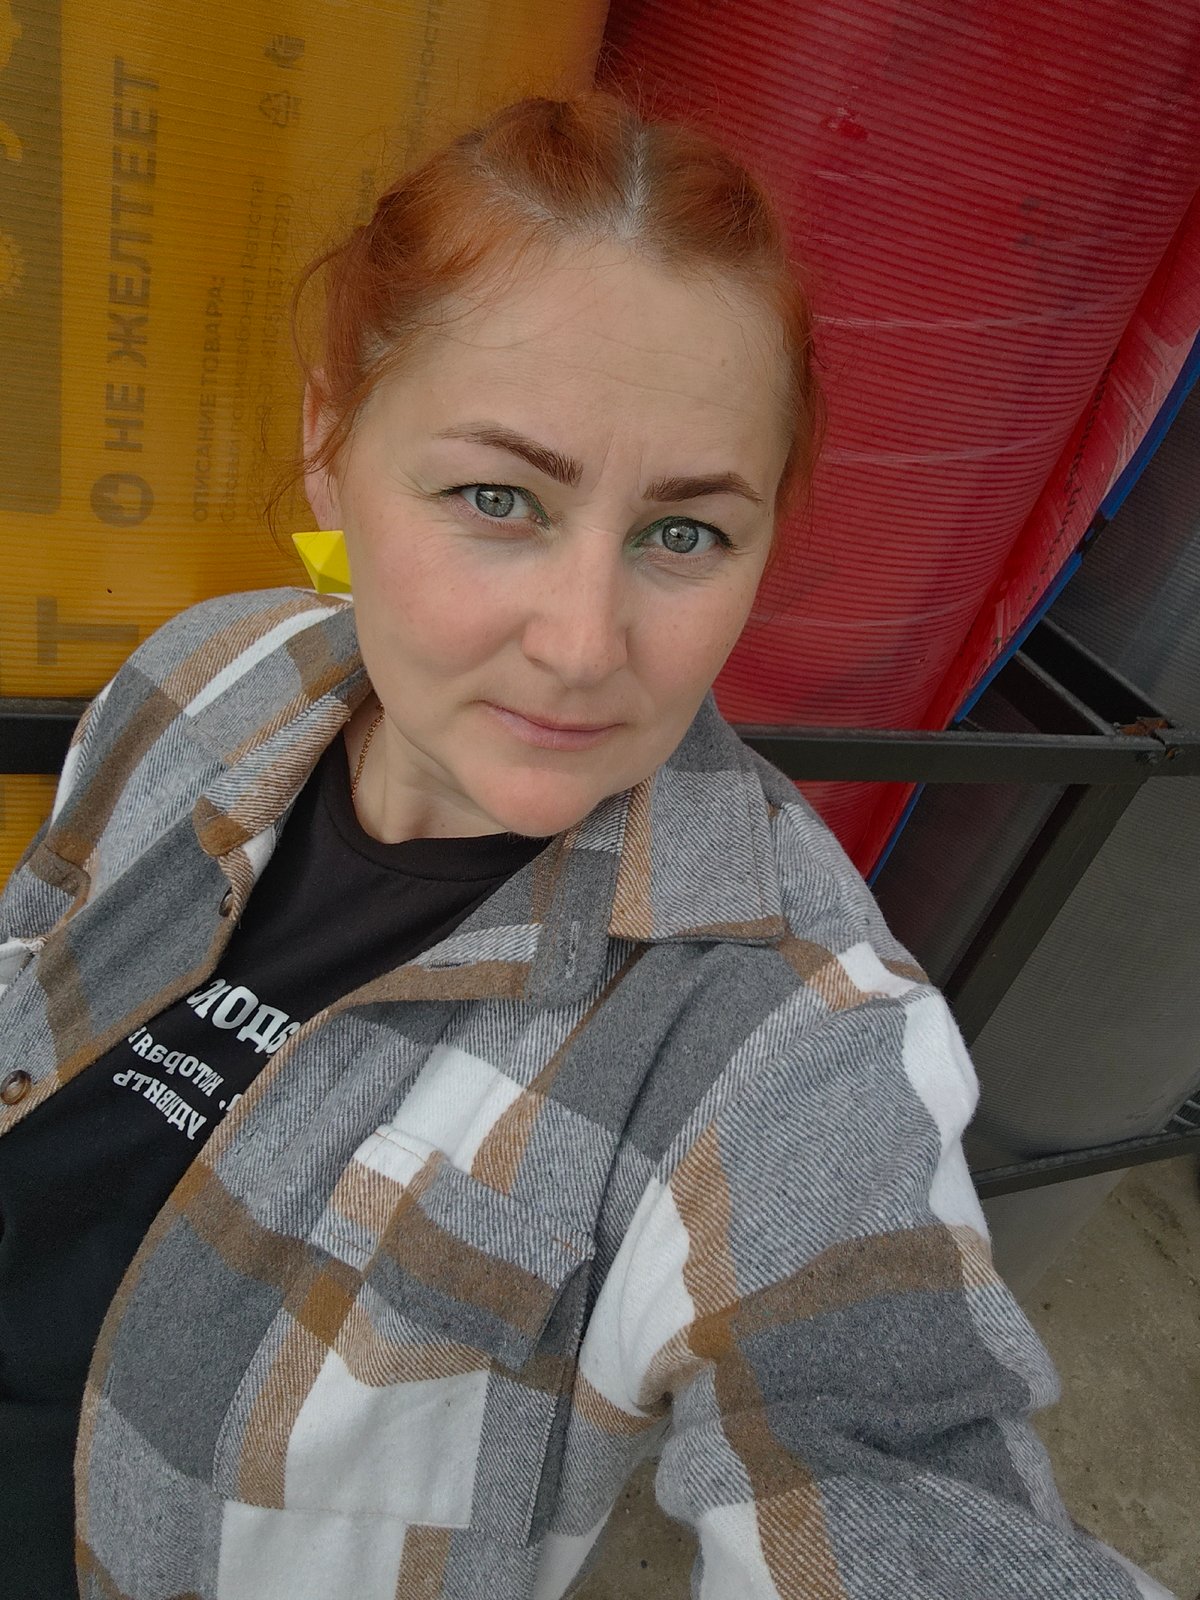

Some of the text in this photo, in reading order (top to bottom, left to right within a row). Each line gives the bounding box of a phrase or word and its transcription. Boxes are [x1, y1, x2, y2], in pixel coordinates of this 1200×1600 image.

[104, 55, 160, 454] НЕ ЖЕЛТЕЕТ
[192, 393, 218, 523] ОПИСАНИЕ
